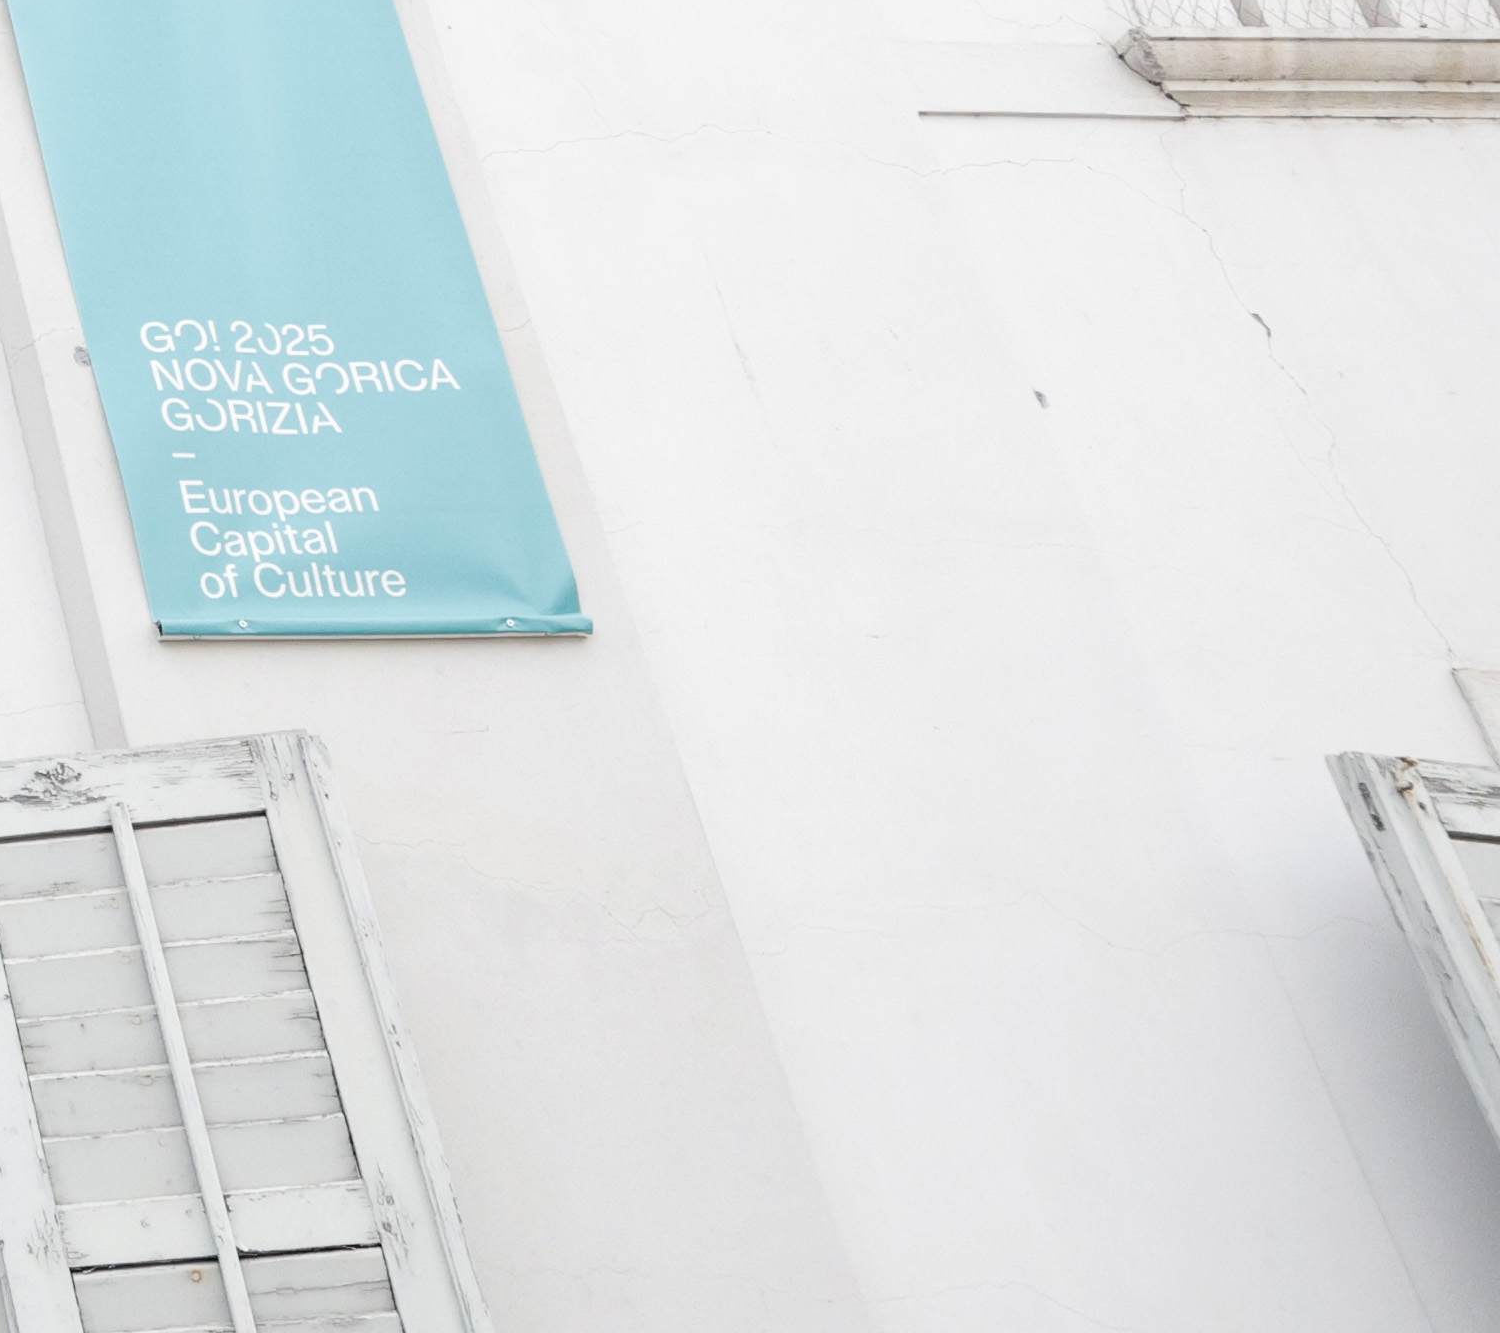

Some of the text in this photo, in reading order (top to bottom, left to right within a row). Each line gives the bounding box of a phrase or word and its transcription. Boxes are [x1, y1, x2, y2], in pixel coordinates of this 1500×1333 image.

[139, 319, 336, 357] GO! 2025
[149, 358, 462, 396] NOVA GORICA
[160, 397, 344, 435] GORIZIA
[179, 479, 380, 522] European
[189, 520, 339, 563] Capital
[200, 562, 407, 599] of Culture
